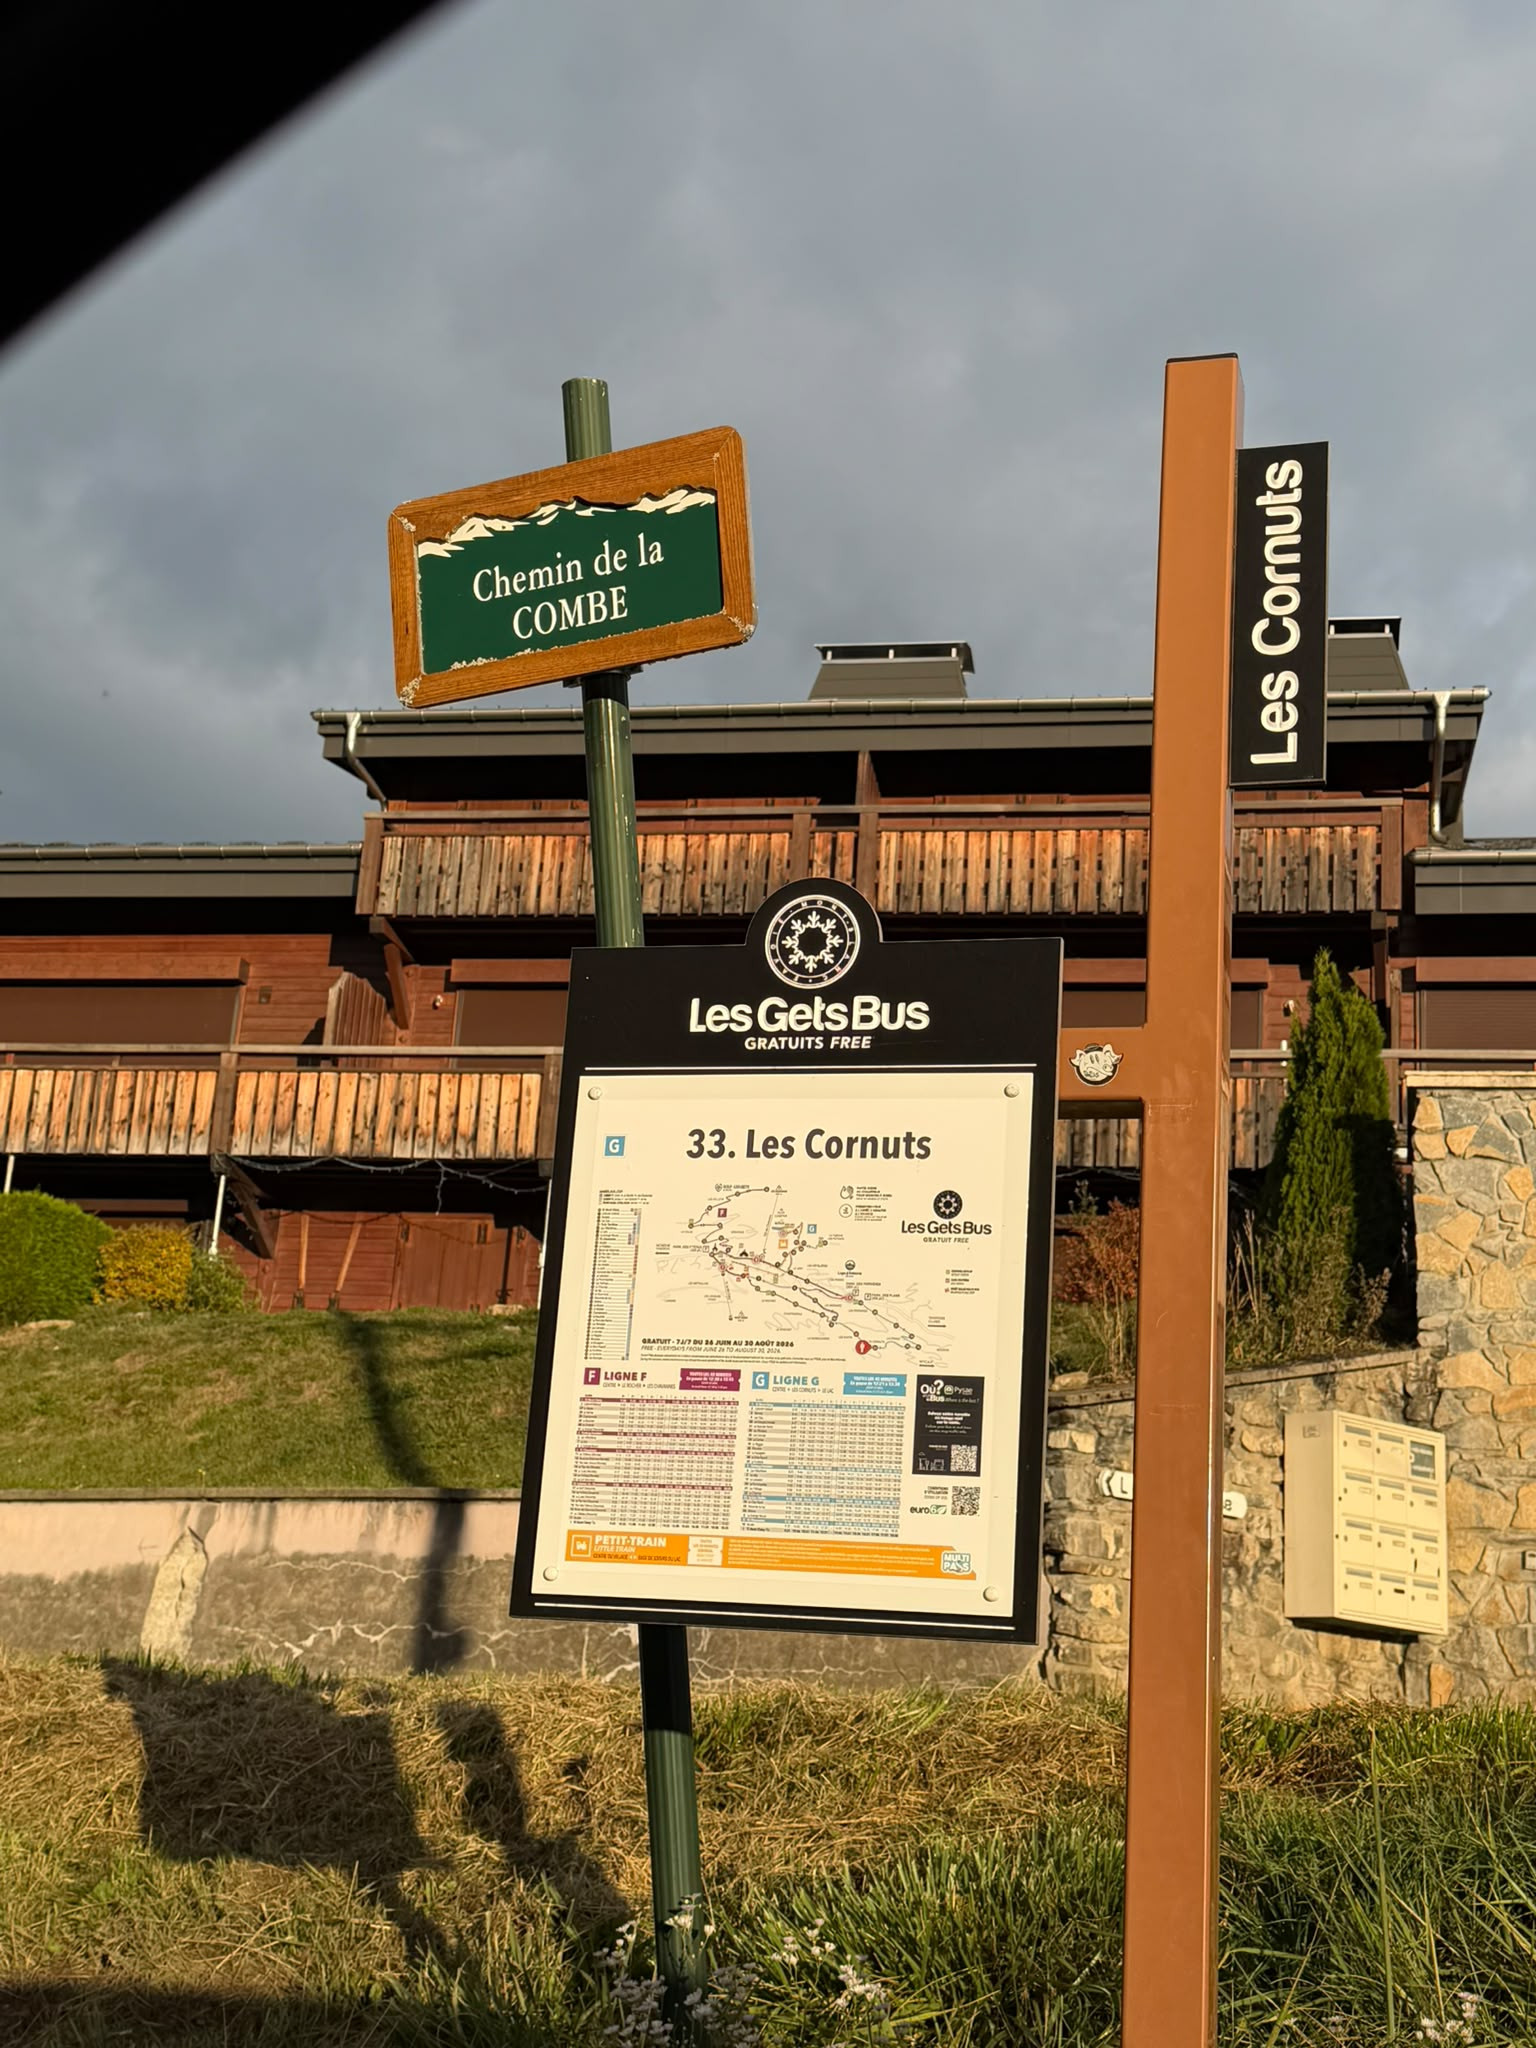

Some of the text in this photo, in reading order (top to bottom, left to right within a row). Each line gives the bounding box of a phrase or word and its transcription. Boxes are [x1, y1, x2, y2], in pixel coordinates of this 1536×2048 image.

[473, 532, 664, 602] Chemin de la
[512, 585, 629, 640] COMBE
[1250, 459, 1303, 765] Les Cornuts
[744, 1036, 872, 1050] GRATUITS FREE
[608, 1138, 620, 1154] G
[686, 1128, 932, 1159] 33. Les Cornuts
[588, 1370, 596, 1382] F
[604, 1371, 647, 1381] LIGNE F
[755, 1374, 765, 1387] G
[773, 1376, 819, 1386] LIGNE G
[943, 1552, 970, 1562] MULTI
